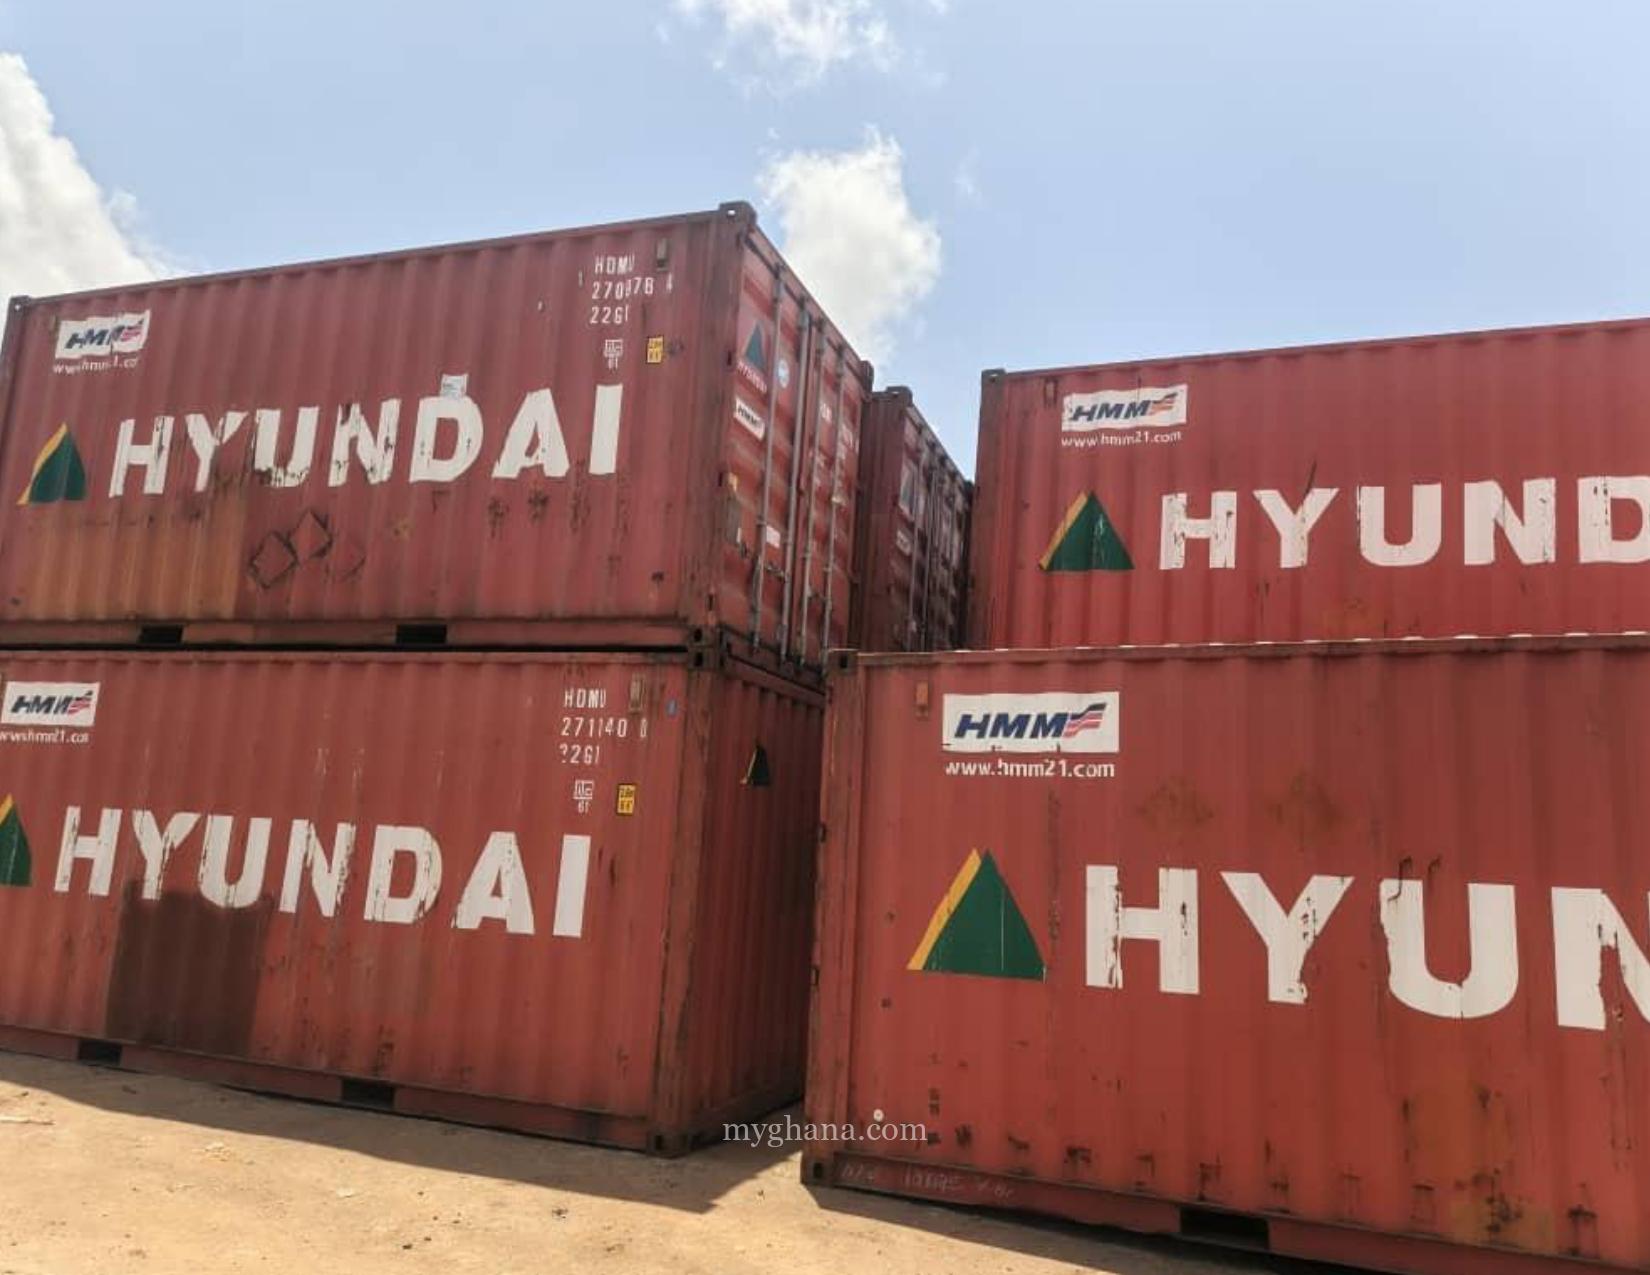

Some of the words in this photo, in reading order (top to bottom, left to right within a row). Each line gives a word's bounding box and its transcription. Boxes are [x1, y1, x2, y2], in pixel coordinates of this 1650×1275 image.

[108, 382, 624, 499] HYUNDAI
[1069, 399, 1151, 422] HMM
[1159, 476, 1650, 571] HYUND
[954, 712, 1069, 739] HMM
[945, 757, 1116, 779] www.hmm21.com
[54, 805, 592, 939] HYUNDAI
